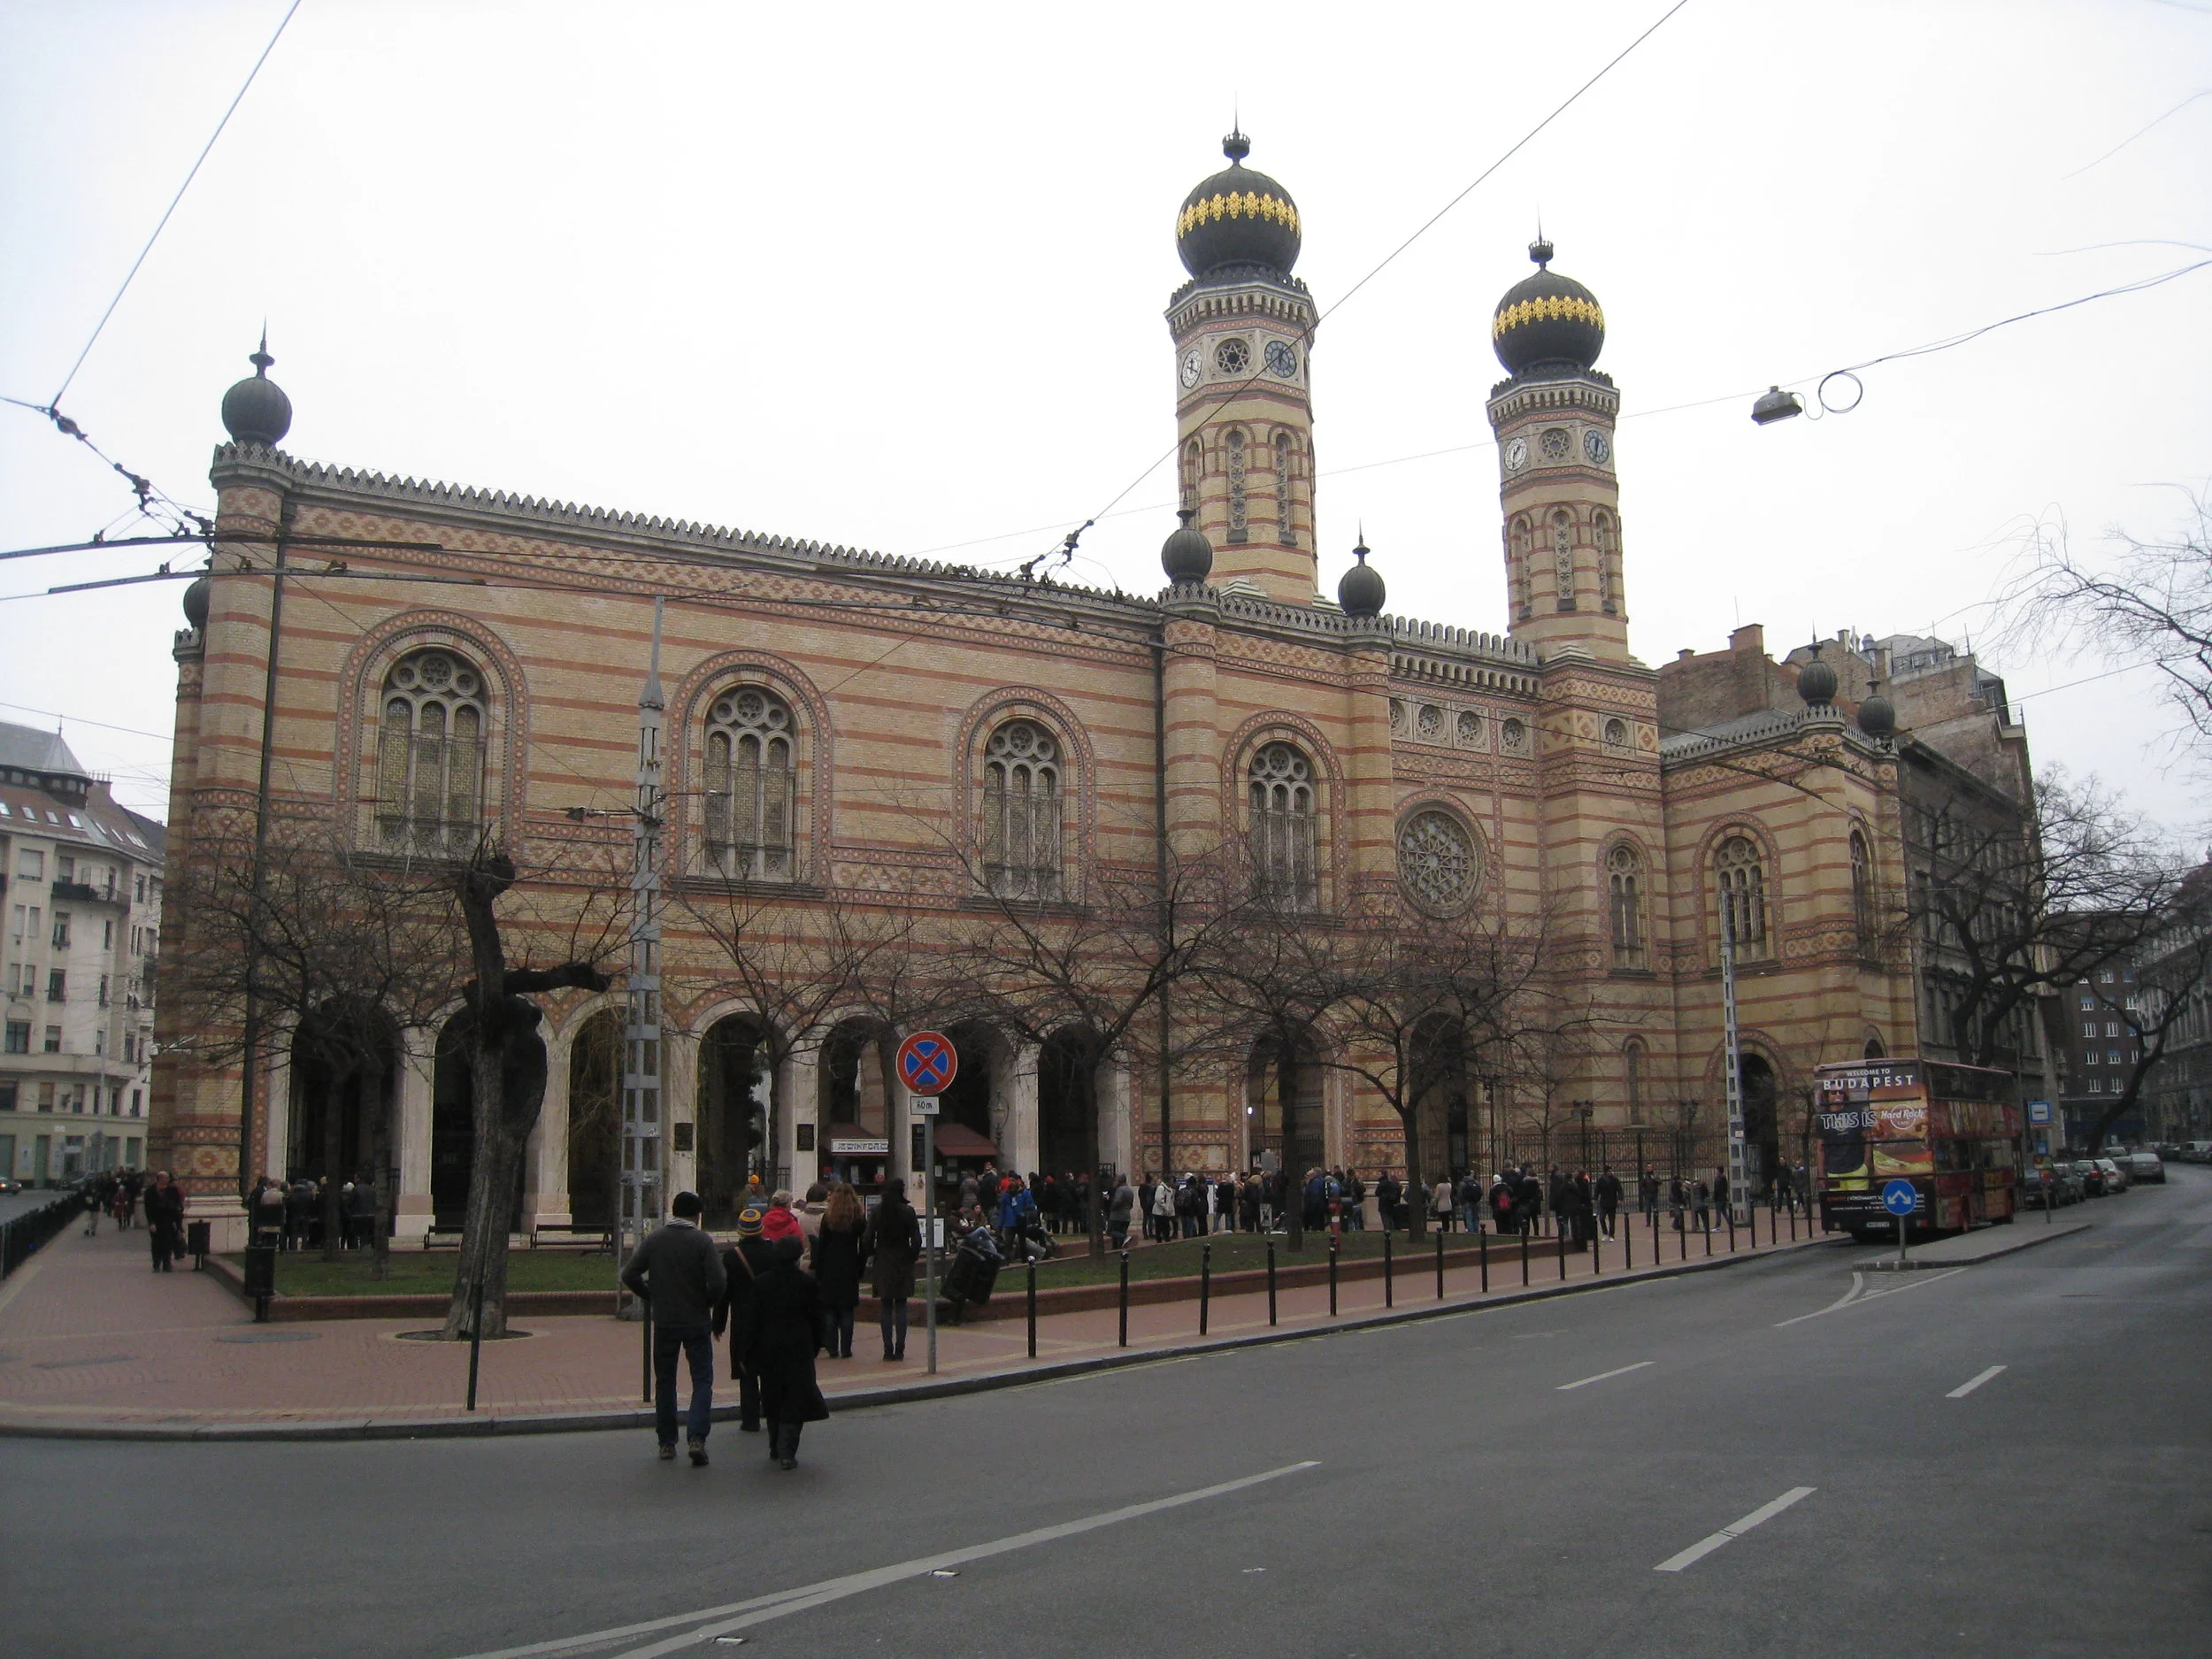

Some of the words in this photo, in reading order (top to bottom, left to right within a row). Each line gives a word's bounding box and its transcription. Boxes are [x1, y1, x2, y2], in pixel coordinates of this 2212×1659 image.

[1846, 1068, 1879, 1077] WELCOME
[1823, 1074, 1914, 1091] BUDAPEST
[1821, 1111, 1860, 1130] THIS
[1861, 1110, 1878, 1128] IS
[1880, 1110, 1902, 1120] Hard
[1902, 1109, 1924, 1119] Rock
